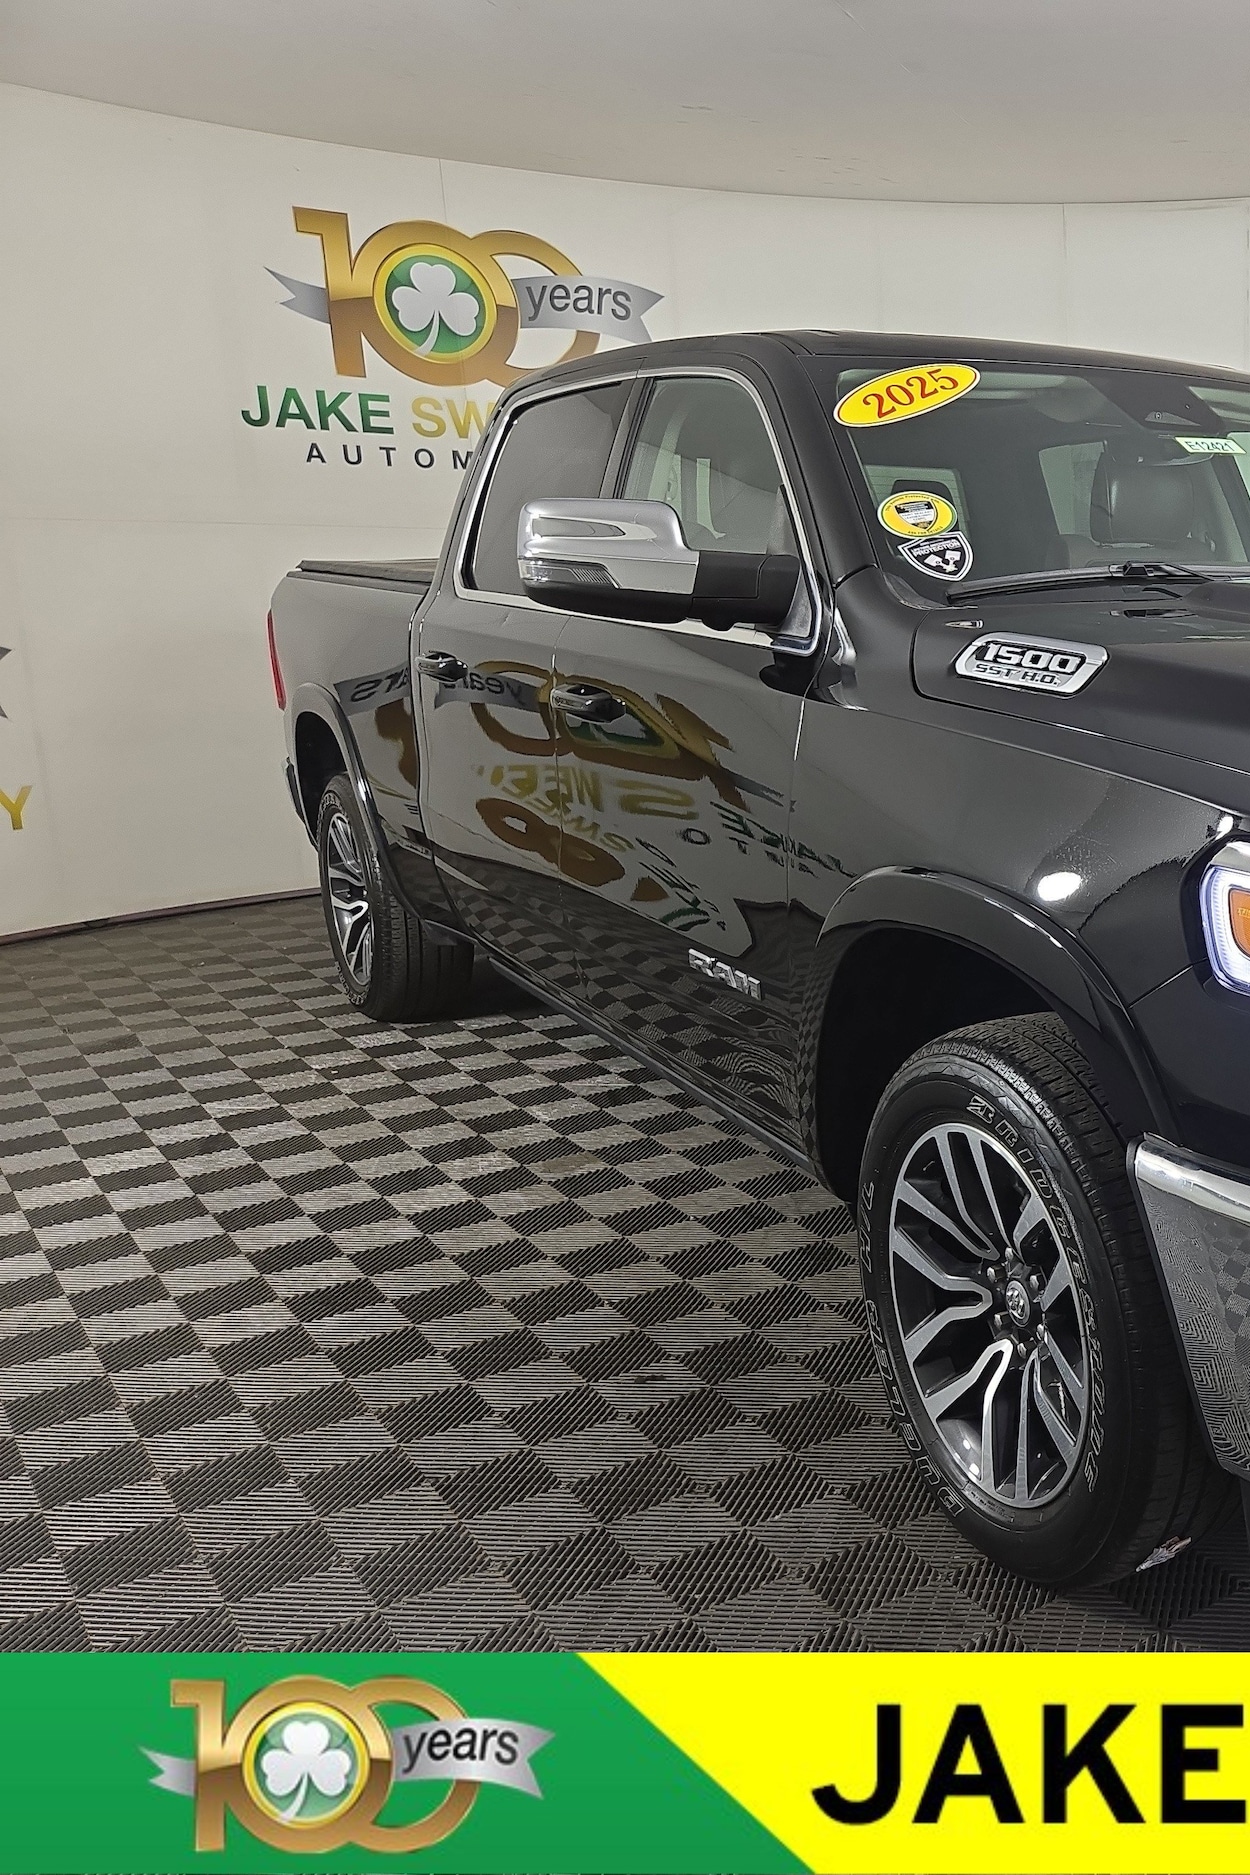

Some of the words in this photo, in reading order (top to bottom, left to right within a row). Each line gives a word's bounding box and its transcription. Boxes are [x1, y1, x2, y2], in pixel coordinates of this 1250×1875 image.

[525, 283, 632, 323] years
[241, 385, 394, 435] JAKE
[863, 368, 959, 418] 2025
[306, 442, 475, 471] AUTOM
[1184, 440, 1235, 452] E12421
[974, 663, 1021, 679] SST
[983, 643, 1081, 674] 1500
[688, 948, 761, 1001] RAM
